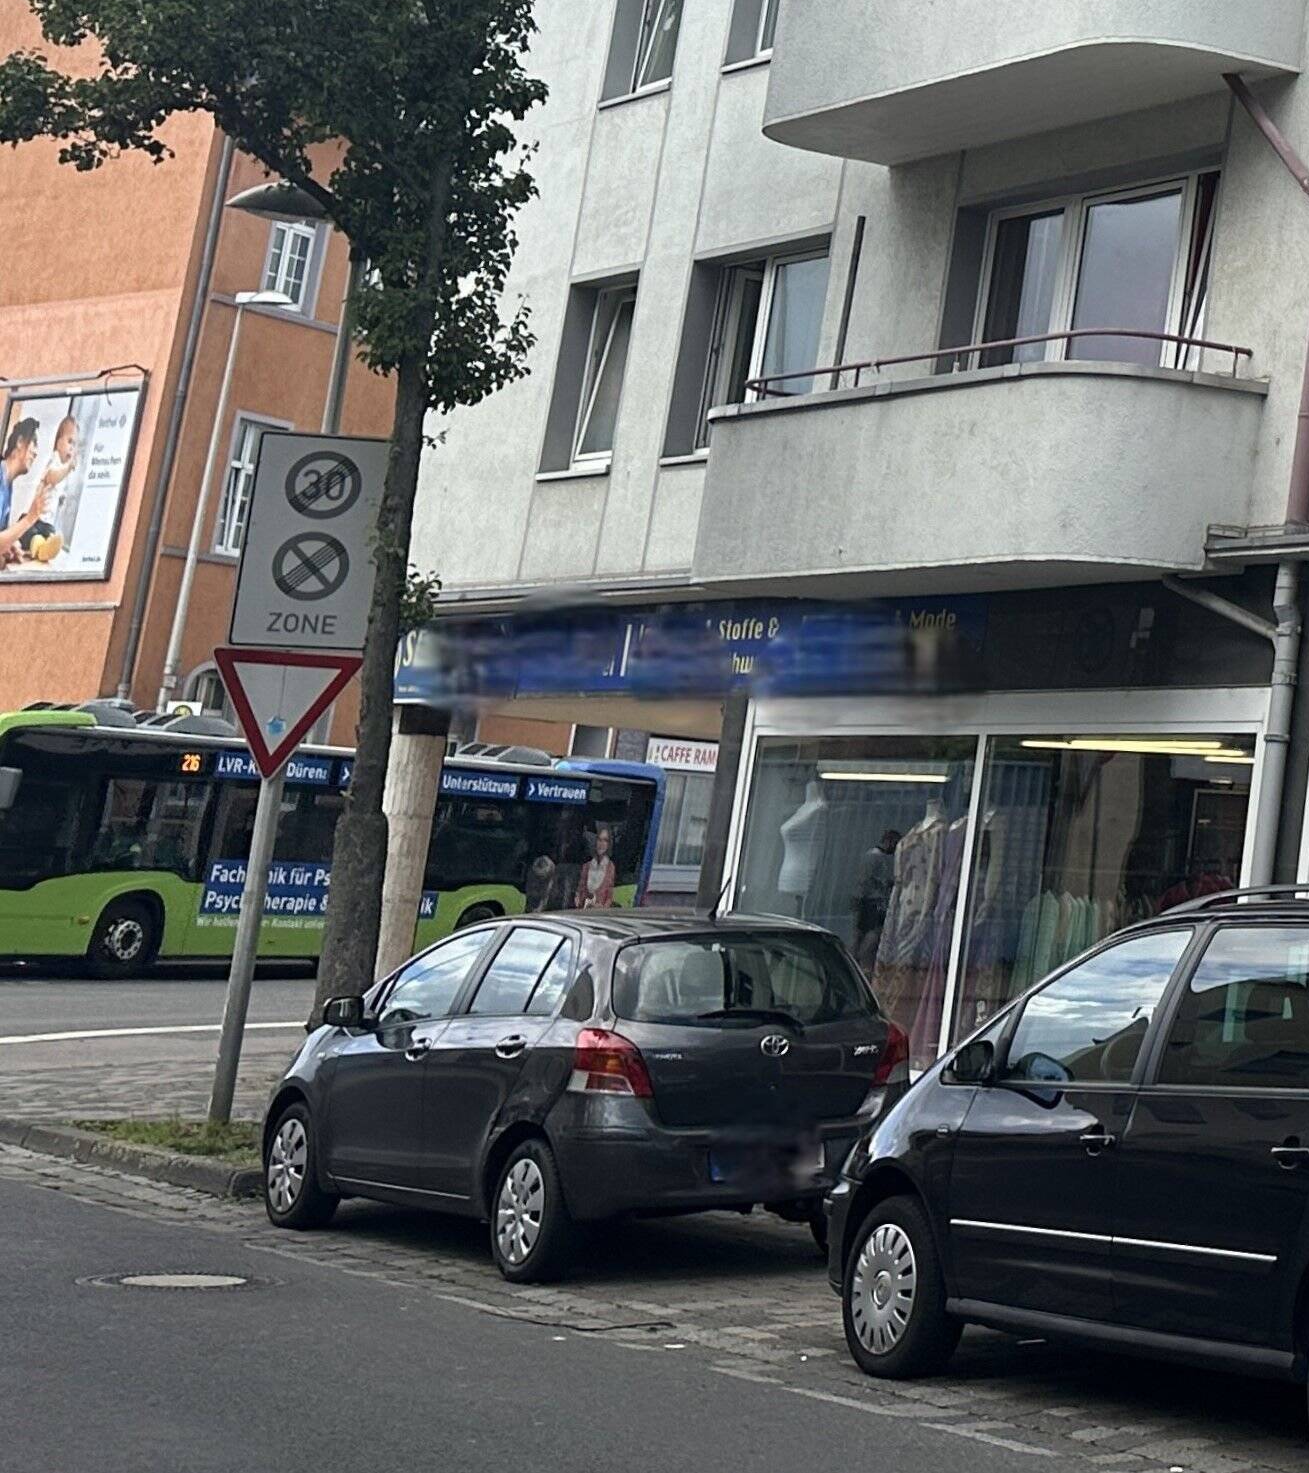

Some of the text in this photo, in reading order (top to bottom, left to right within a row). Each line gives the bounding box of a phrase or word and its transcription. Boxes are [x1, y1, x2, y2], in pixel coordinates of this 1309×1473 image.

[302, 469, 346, 501] 30
[266, 612, 338, 635] ZONE
[719, 616, 780, 641] Stoffe &
[661, 745, 692, 764] CAFFE
[442, 775, 517, 796] Unterstützung
[538, 782, 586, 800] Vertrauen
[288, 867, 312, 885] für
